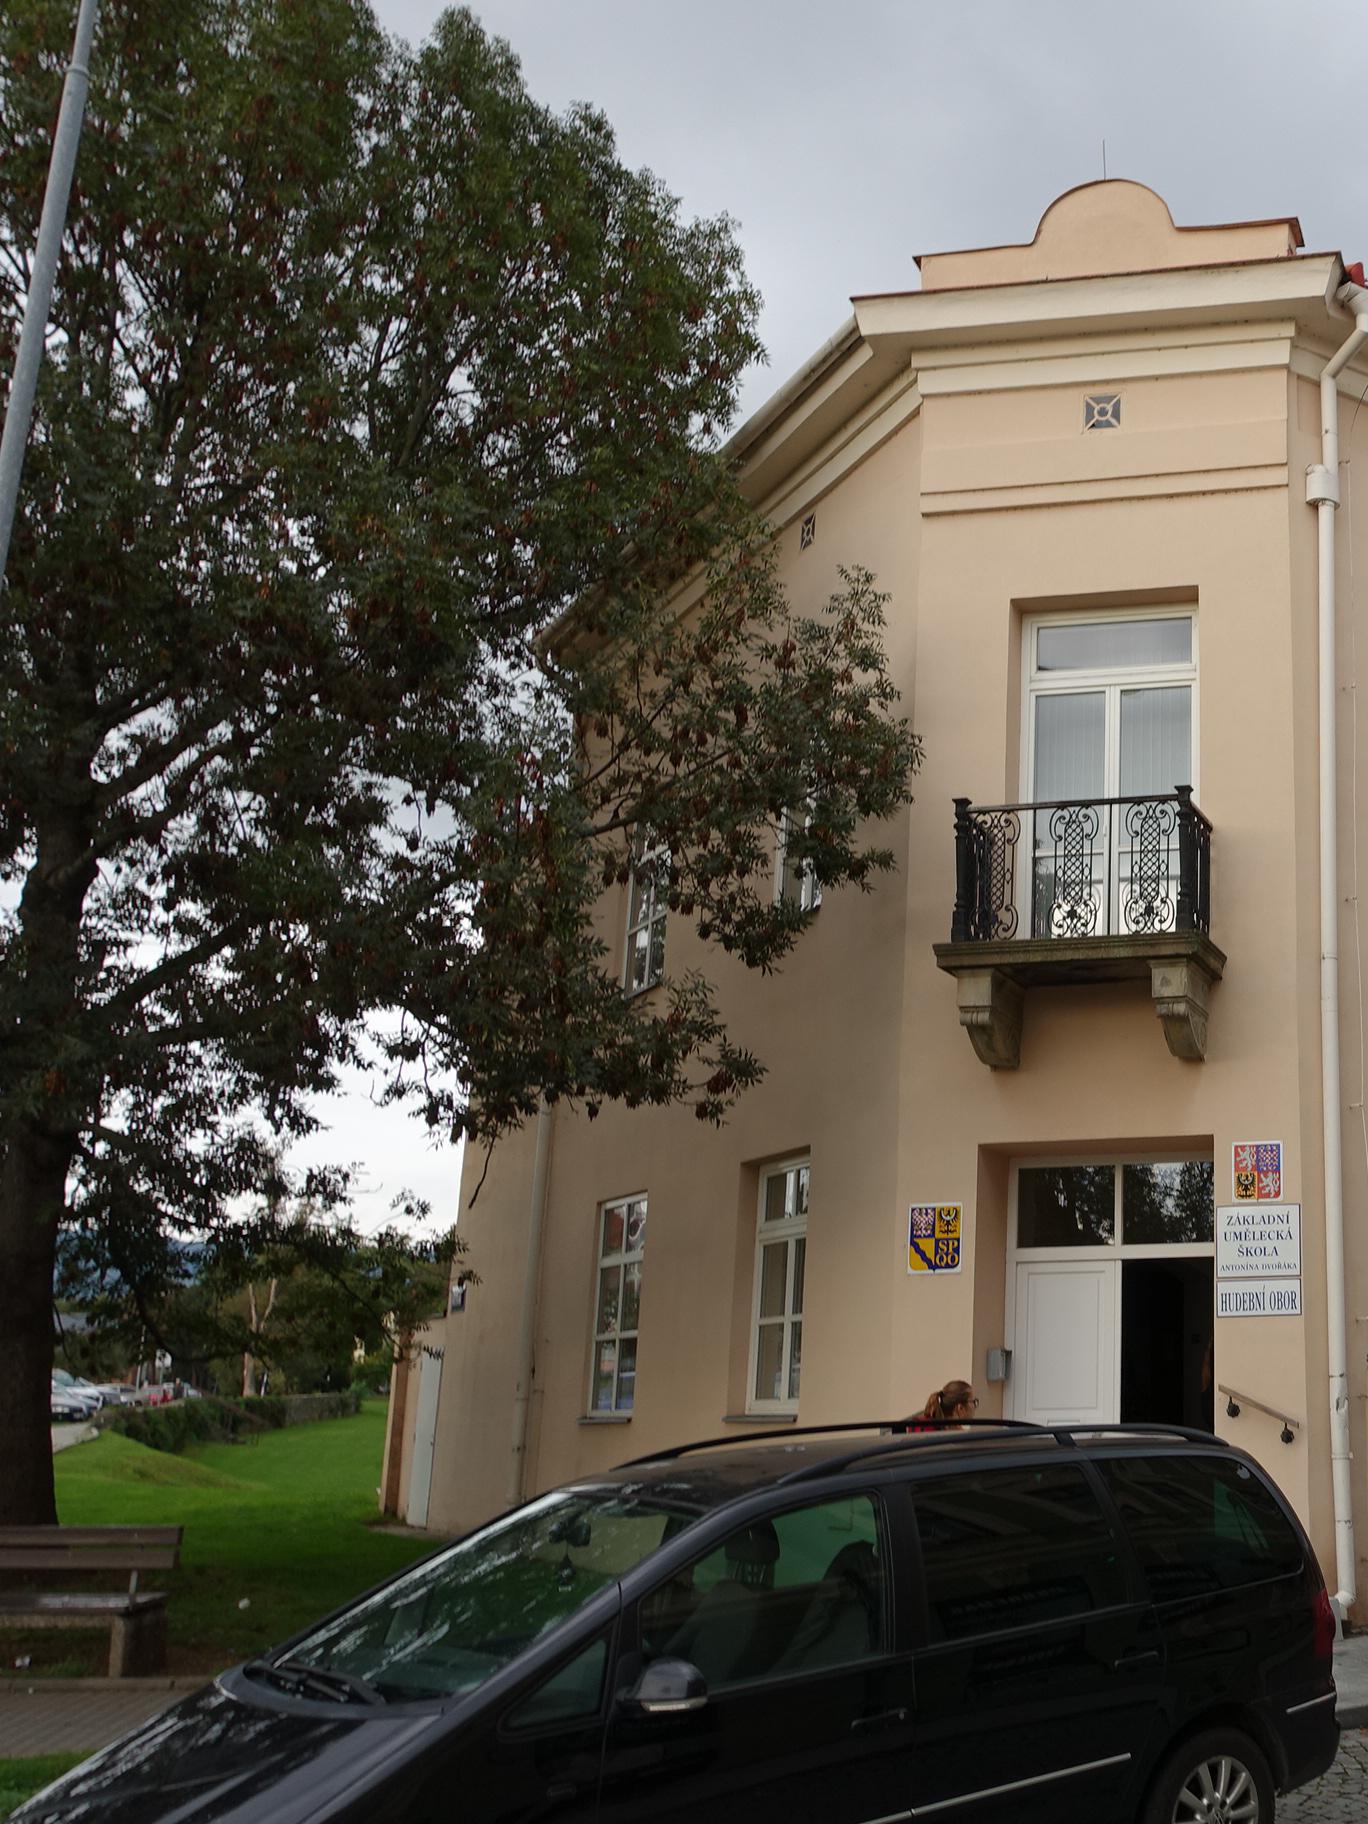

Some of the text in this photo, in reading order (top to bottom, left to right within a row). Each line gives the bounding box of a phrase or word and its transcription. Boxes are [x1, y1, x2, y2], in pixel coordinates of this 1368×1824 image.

[1226, 1210, 1290, 1226] ZÁKLADNÍ
[1223, 1227, 1293, 1242] UMĚLECKÁ
[1237, 1244, 1279, 1257] ŠKOLA
[1220, 1261, 1297, 1272] ANTONÍNA DVOŘÁKA
[1221, 1284, 1297, 1312] HUDEBNÍ OBOR
